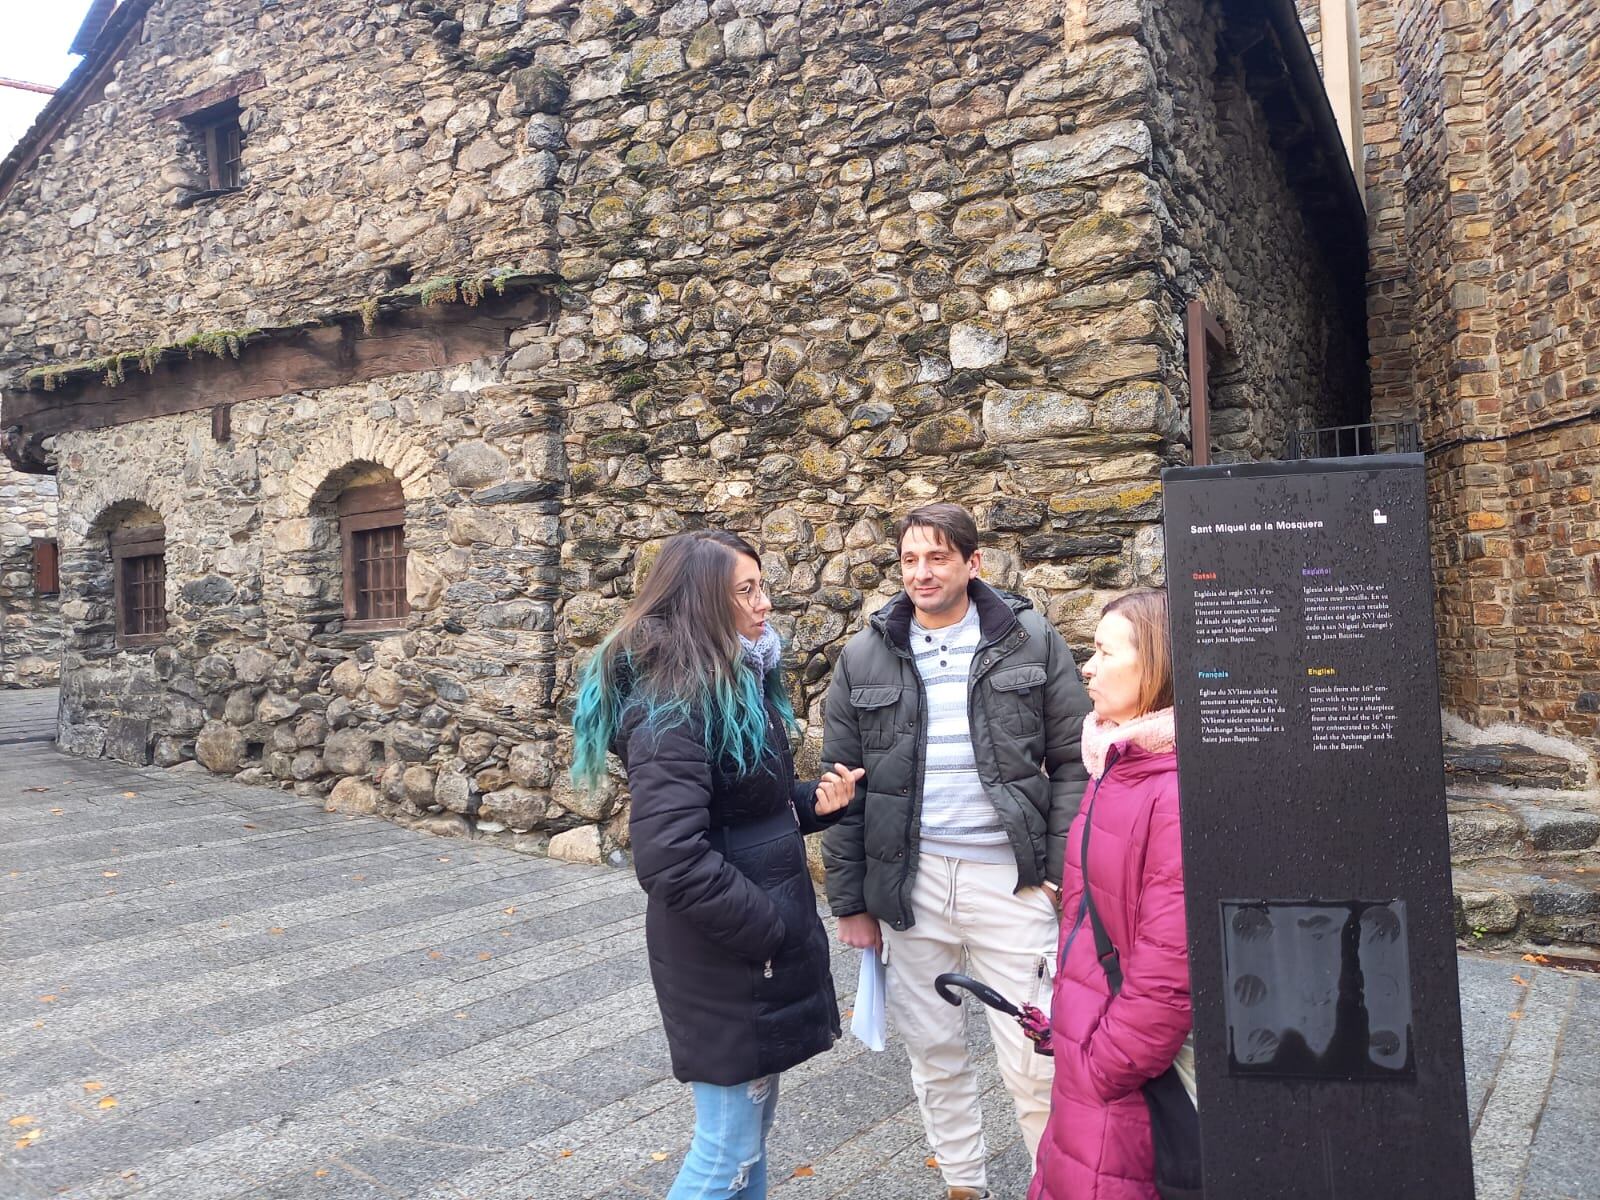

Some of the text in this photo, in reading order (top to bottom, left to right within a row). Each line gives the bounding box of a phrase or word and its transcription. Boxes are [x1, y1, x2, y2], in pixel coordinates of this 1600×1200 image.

[1191, 525, 1212, 534] Sant
[1215, 524, 1247, 533] Miquel
[1264, 522, 1273, 530] la
[1276, 520, 1323, 530] Mosquera
[1347, 613, 1360, 621] siglo
[1225, 626, 1246, 635] Miquel
[1199, 671, 1228, 680] Français
[1361, 695, 1380, 703] simple
[1341, 733, 1371, 741] Archangel
[1341, 742, 1364, 751] Baptist.
